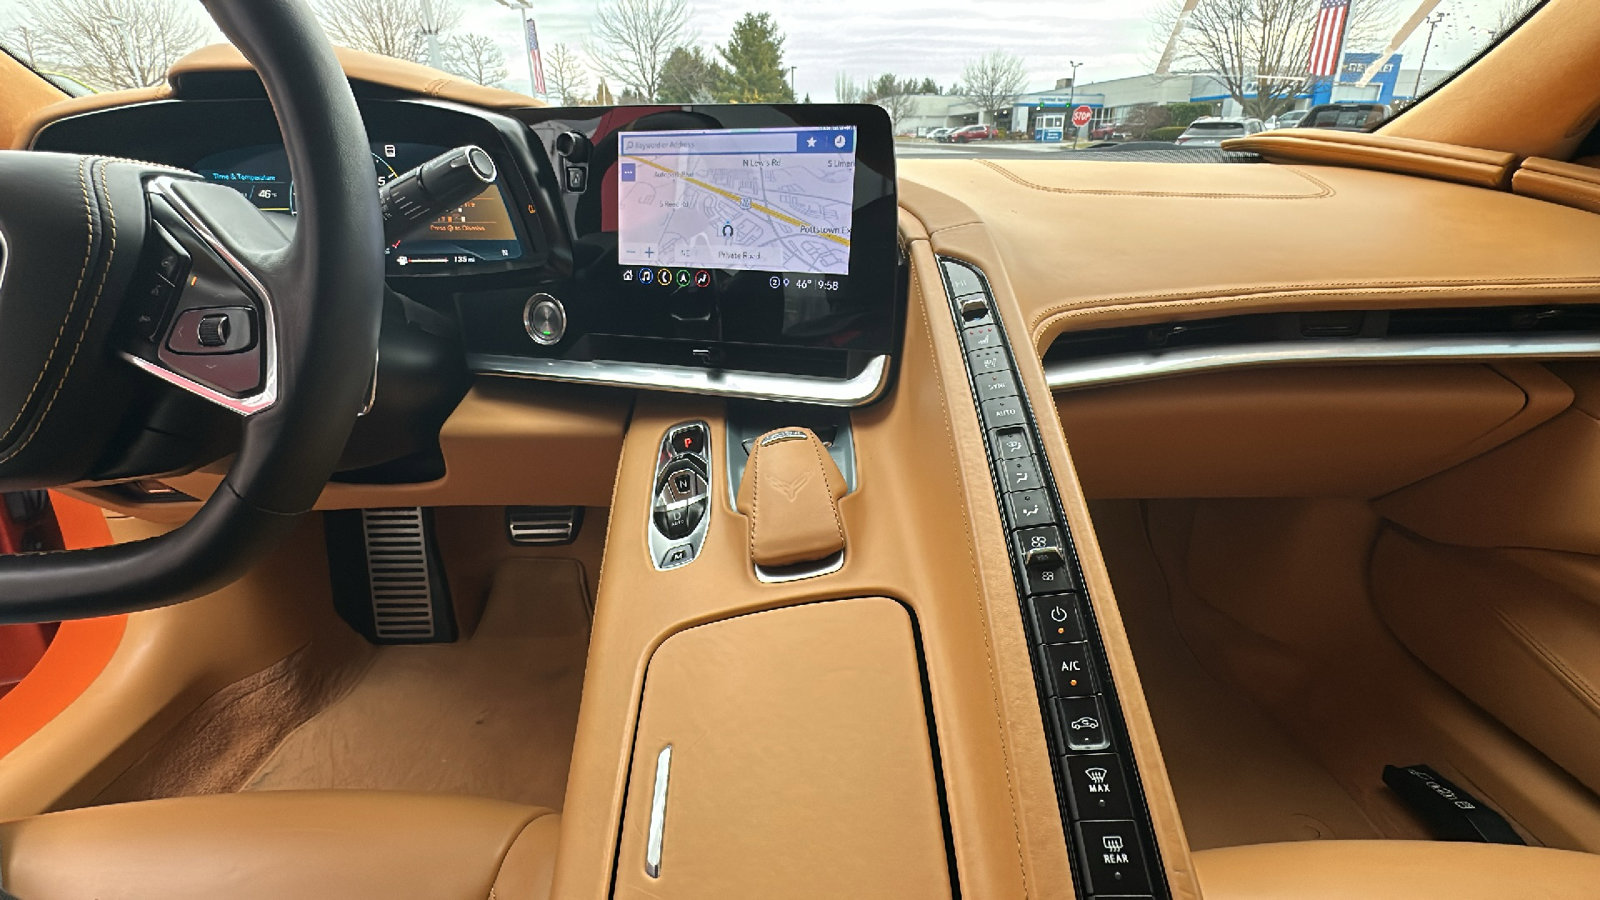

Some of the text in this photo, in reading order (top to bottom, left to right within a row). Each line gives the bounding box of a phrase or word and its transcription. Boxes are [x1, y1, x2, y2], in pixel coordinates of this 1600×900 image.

[1073, 112, 1091, 121] STOP
[212, 172, 276, 182] Time & Temperature
[377, 176, 386, 187] 5
[718, 251, 741, 259] Private
[817, 280, 839, 291] 9:58
[996, 408, 1016, 416] AUTO
[684, 437, 692, 448] P
[679, 479, 688, 489] N
[673, 510, 682, 521] D
[674, 552, 684, 560] M
[1060, 660, 1081, 673] A/C
[1088, 783, 1111, 793] MAX
[1103, 853, 1129, 865] REAR
